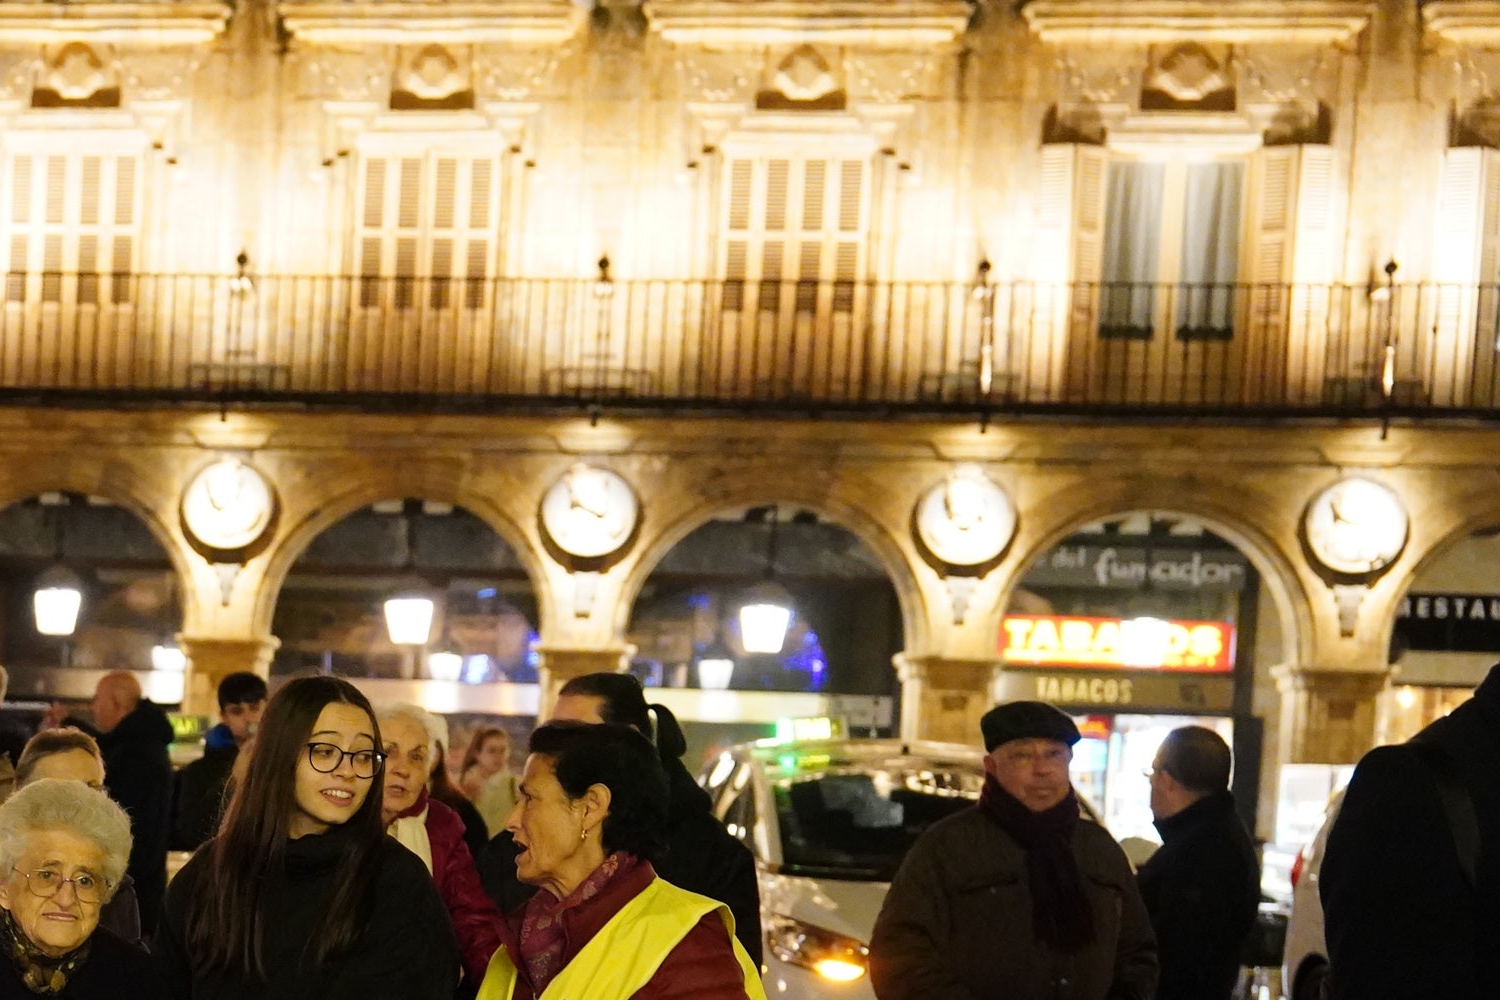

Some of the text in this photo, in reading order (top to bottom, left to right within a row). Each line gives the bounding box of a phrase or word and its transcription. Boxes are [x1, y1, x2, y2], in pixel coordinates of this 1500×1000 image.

[1093, 548, 1243, 585] fumador
[1003, 617, 1223, 659] TABAOS
[1036, 676, 1133, 704] TABACOS
